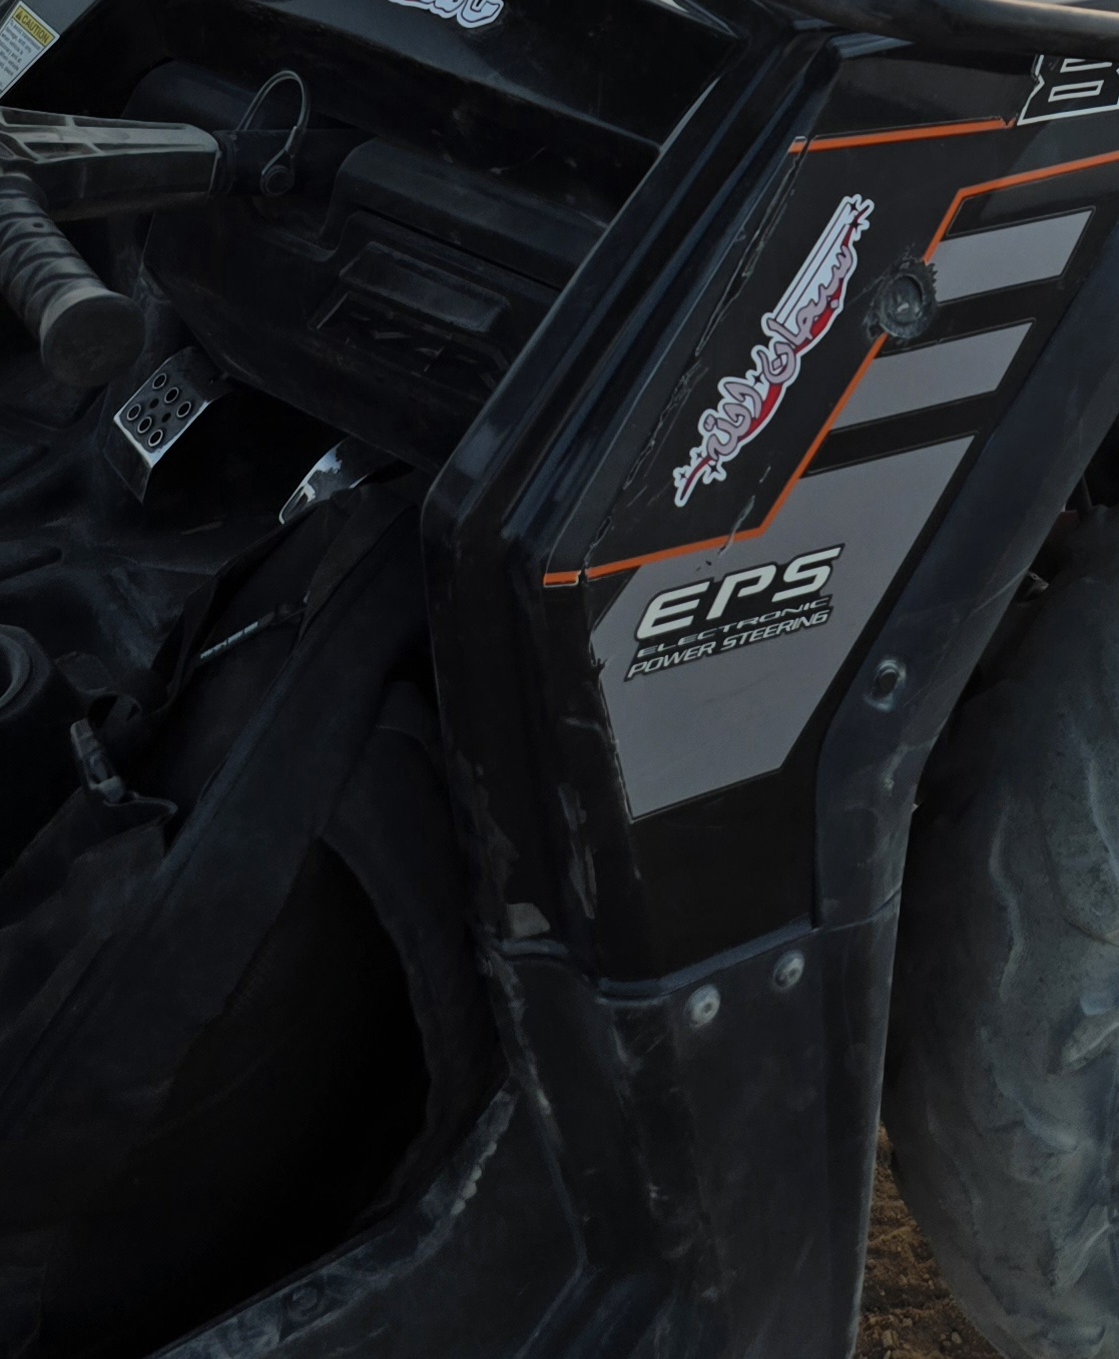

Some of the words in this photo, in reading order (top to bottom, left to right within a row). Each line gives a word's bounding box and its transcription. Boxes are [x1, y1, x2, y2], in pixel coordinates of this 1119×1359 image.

[21, 15, 50, 44] CAUTION
[636, 546, 842, 640] EPS
[626, 641, 716, 679] POWER
[719, 609, 831, 652] STEERING
[636, 597, 830, 659] ELECTRONIC
